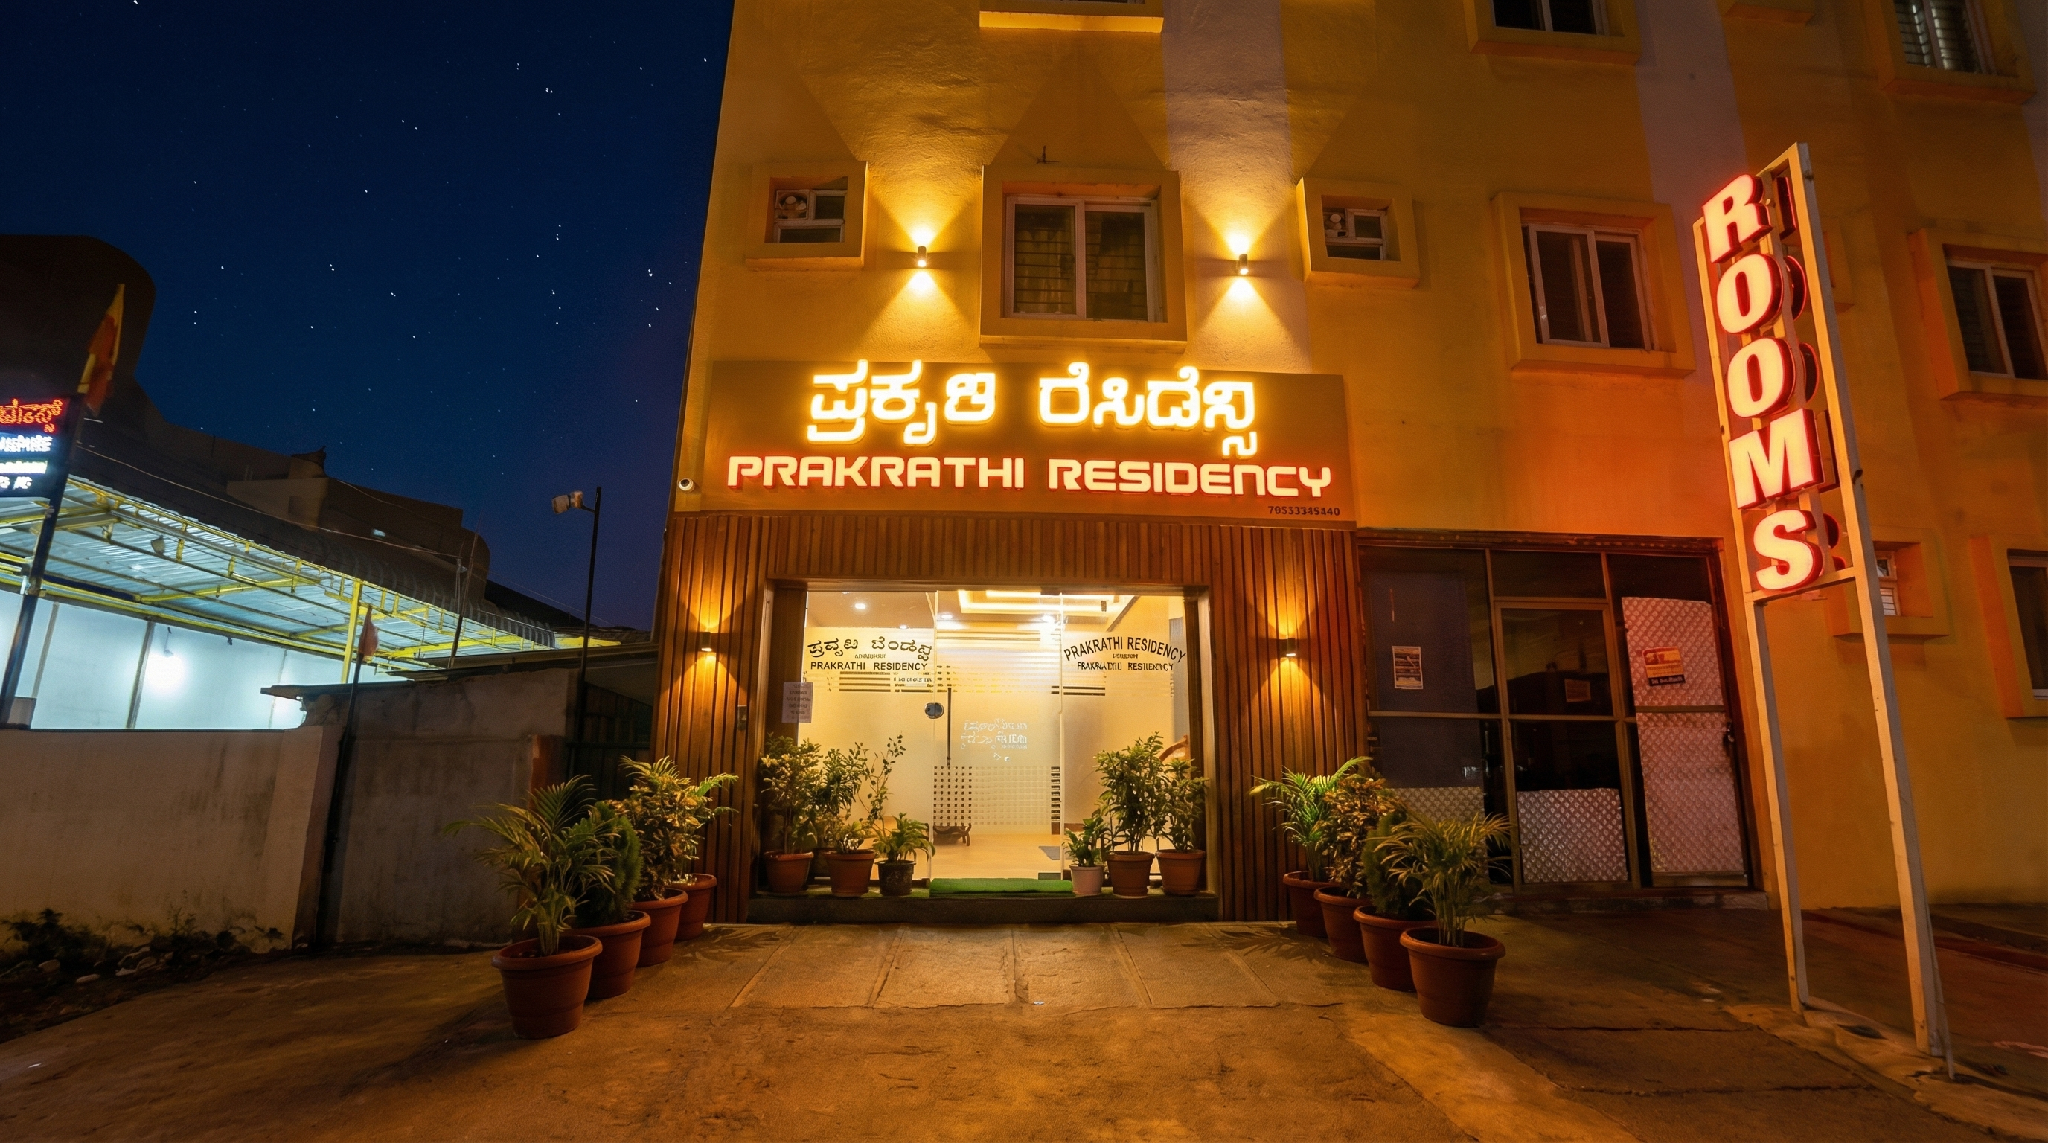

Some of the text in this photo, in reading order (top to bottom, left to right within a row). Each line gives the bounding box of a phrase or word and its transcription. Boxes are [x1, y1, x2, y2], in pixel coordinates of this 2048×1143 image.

[1703, 174, 1823, 592] ROOMS
[727, 455, 1332, 498] PRAKRATHI RESIDENCY
[810, 661, 928, 671] PRAKRATHI RESIDENCY
[1063, 635, 1187, 664] PRAKRATHI RESIDENCY
